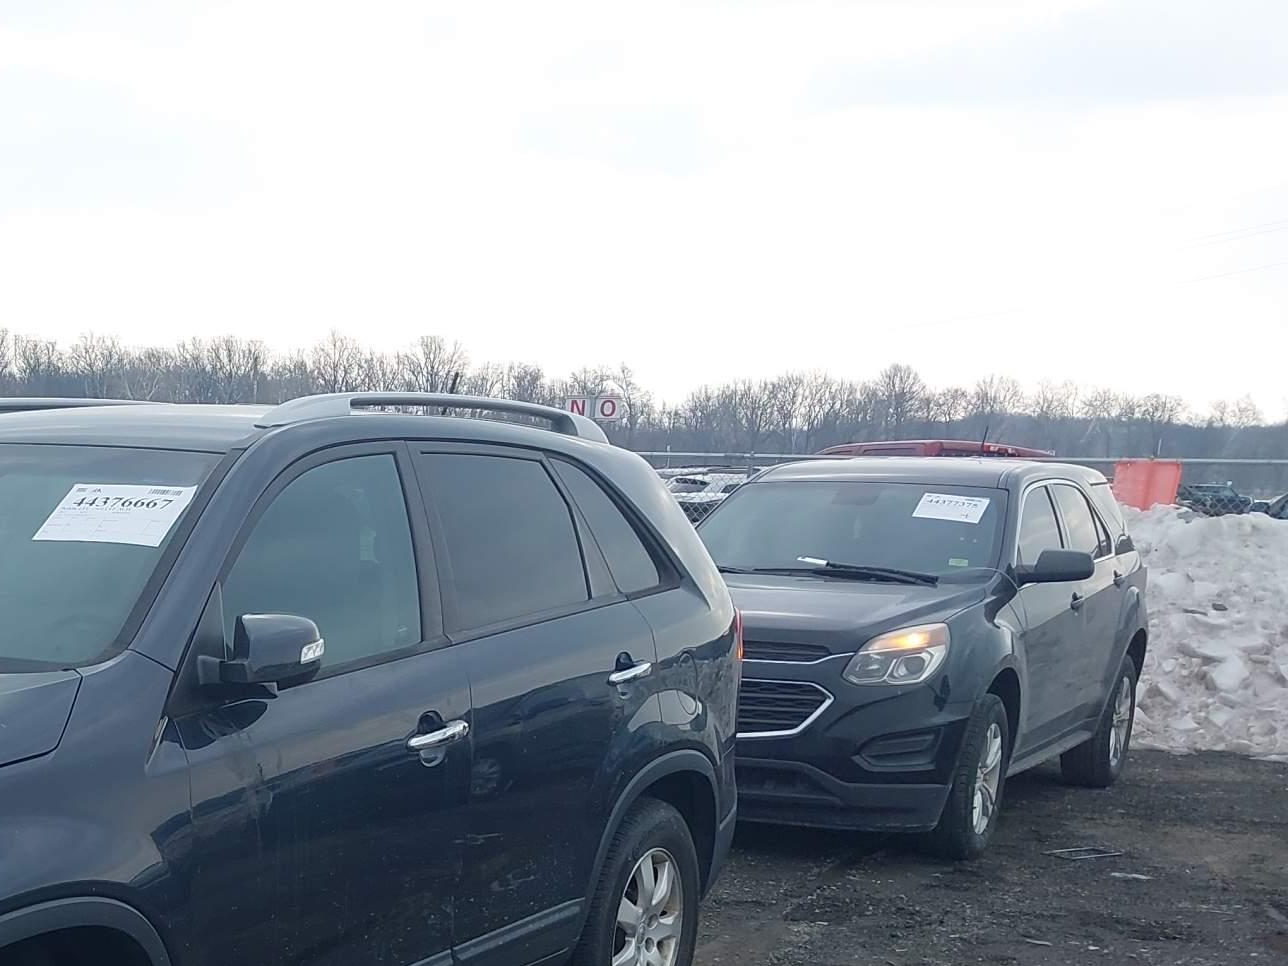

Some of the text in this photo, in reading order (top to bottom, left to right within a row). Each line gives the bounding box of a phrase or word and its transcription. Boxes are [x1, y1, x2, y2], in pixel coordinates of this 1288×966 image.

[570, 399, 617, 418] N O
[72, 496, 175, 511] 44376667
